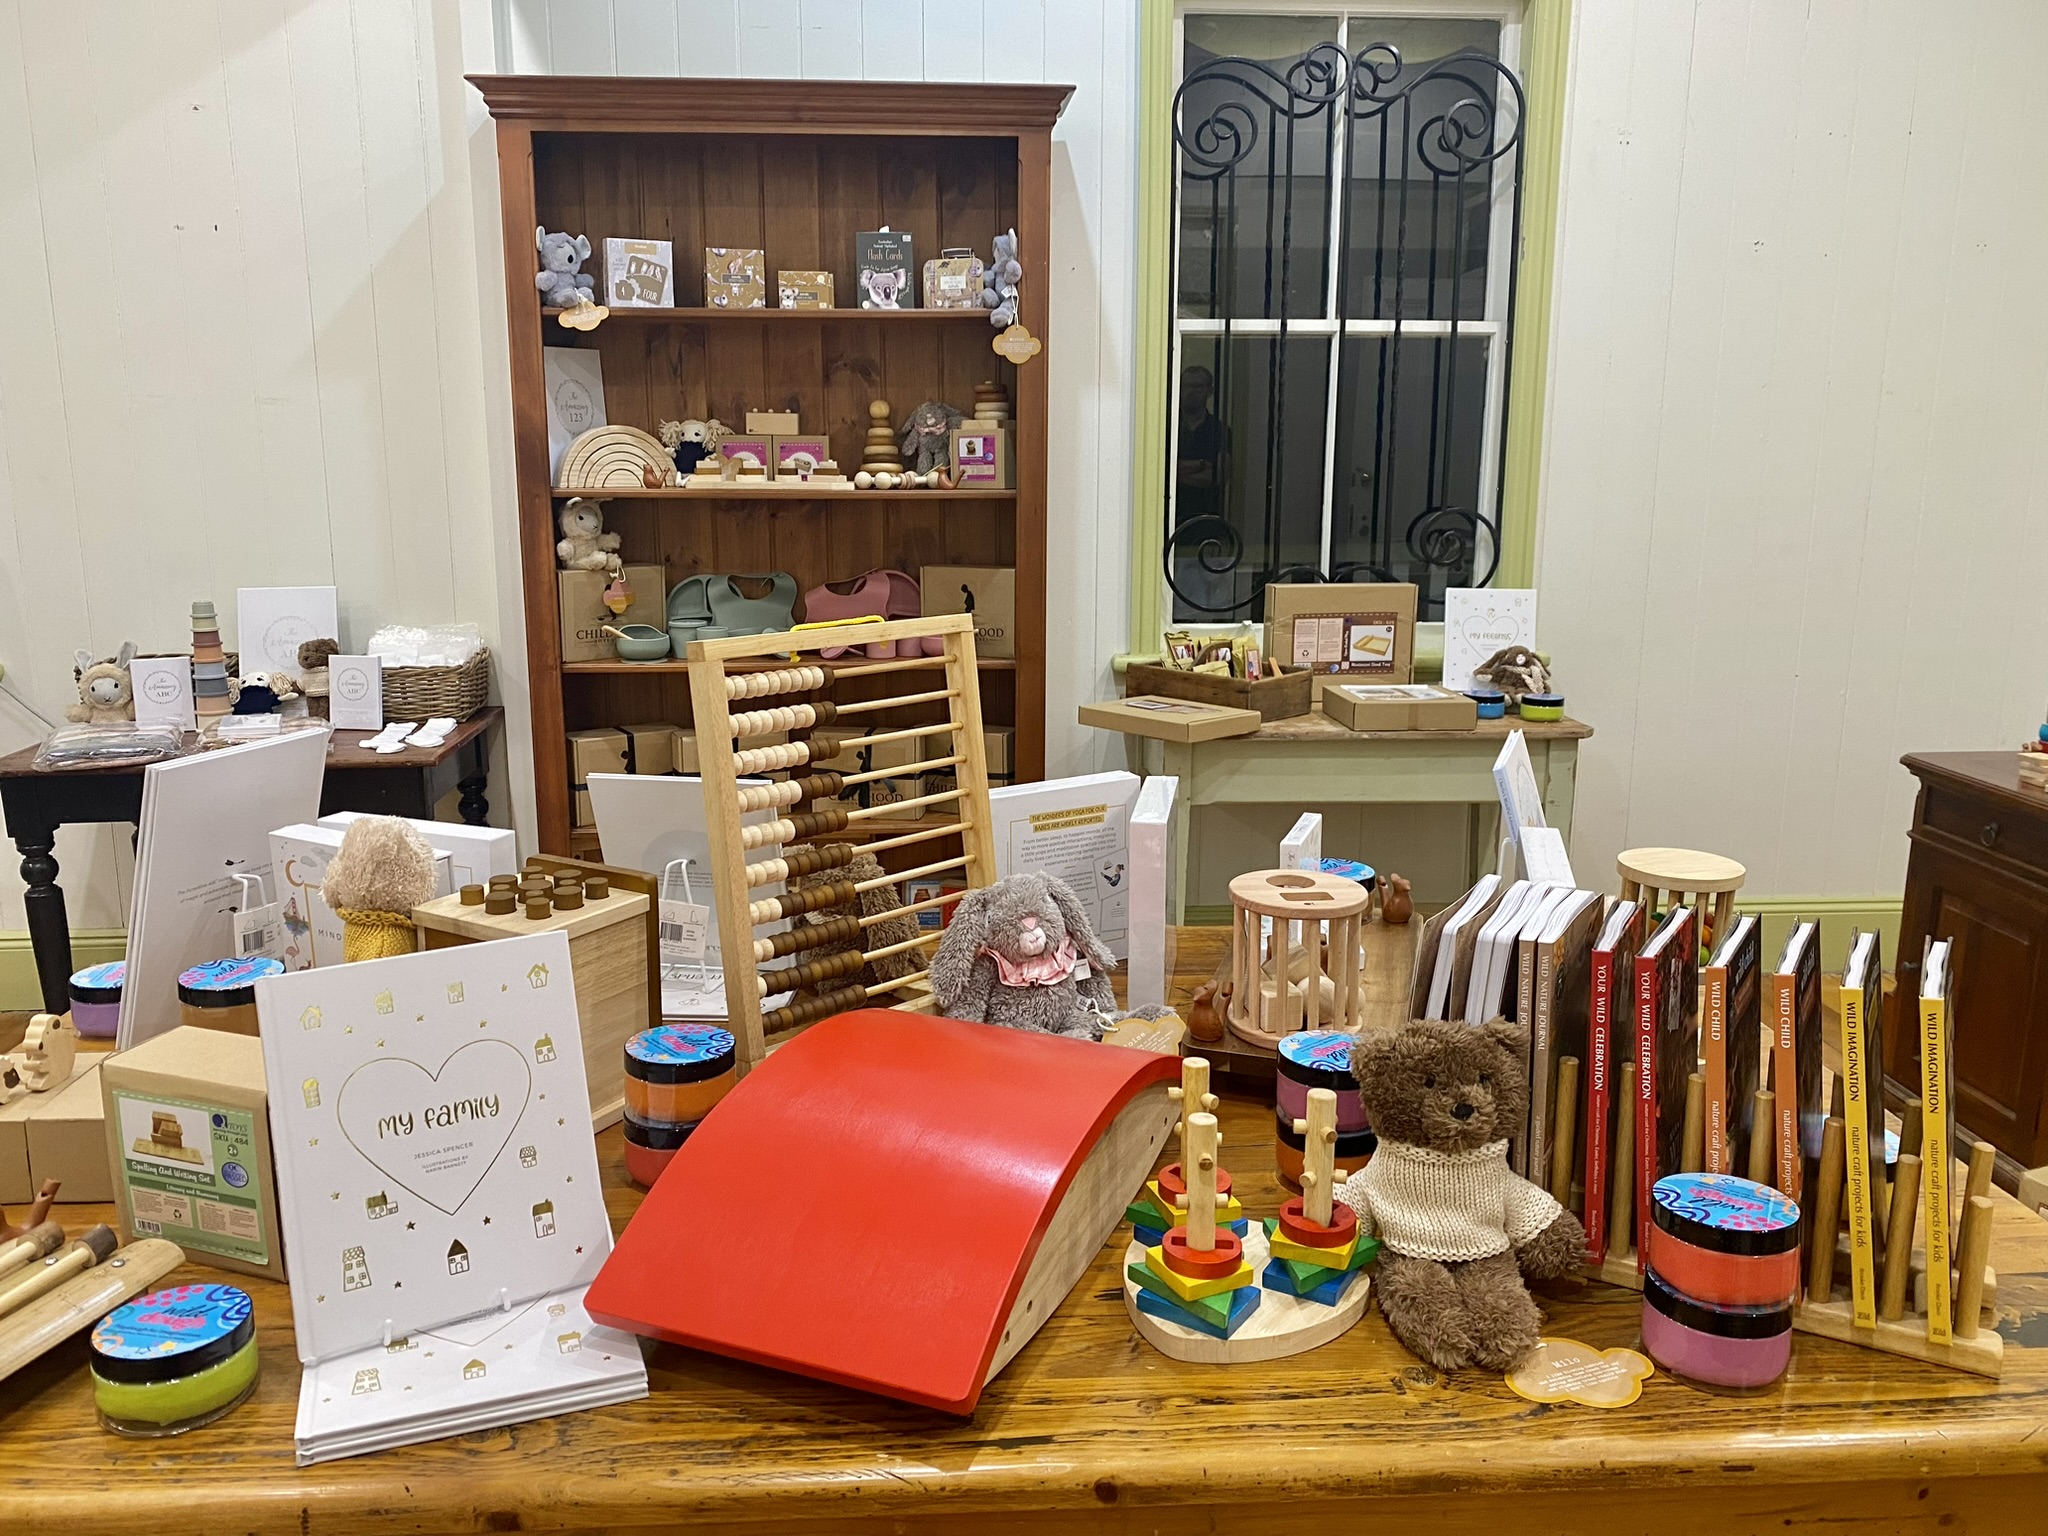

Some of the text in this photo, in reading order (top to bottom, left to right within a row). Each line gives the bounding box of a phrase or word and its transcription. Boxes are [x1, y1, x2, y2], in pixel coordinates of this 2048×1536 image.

[885, 248, 903, 261] Cards
[643, 288, 658, 301] FOUR
[569, 412, 584, 423] 123
[576, 629, 614, 640] CHILD
[926, 783, 957, 794] CHILD
[1041, 812, 1064, 821] WONDERS
[1072, 808, 1085, 817] YOGA
[1522, 953, 1530, 974] WILD
[1520, 978, 1529, 1008] NATURE
[1537, 955, 1549, 1051] WILD NATURE JOURNAL
[1711, 981, 1720, 1040] WILD CHILD
[1780, 988, 1790, 1049] WILD CHILD
[1594, 965, 1607, 1091] YOUR WILD CELEBRATION
[1641, 971, 1651, 1100] YOUR WILD CELEBRATION
[1846, 1002, 1859, 1102] WILD IMAGINATION
[1927, 1012, 1939, 1114] WILD IMAGINATION
[213, 1132, 229, 1143] SKU
[234, 1136, 249, 1146] 484
[1710, 1100, 1722, 1174] nature craft proje
[413, 1141, 474, 1160] JESSICA SPENCER
[1782, 1110, 1794, 1195] nature craft projects
[131, 1161, 158, 1176] Spelling
[173, 1168, 198, 1183] Writing
[198, 1173, 212, 1184] Set
[1851, 1126, 1867, 1248] nature craft projects for kids
[1929, 1139, 1944, 1263] nature craft projects for kids
[161, 1304, 219, 1319] wild
[1551, 1357, 1580, 1369] Milo
